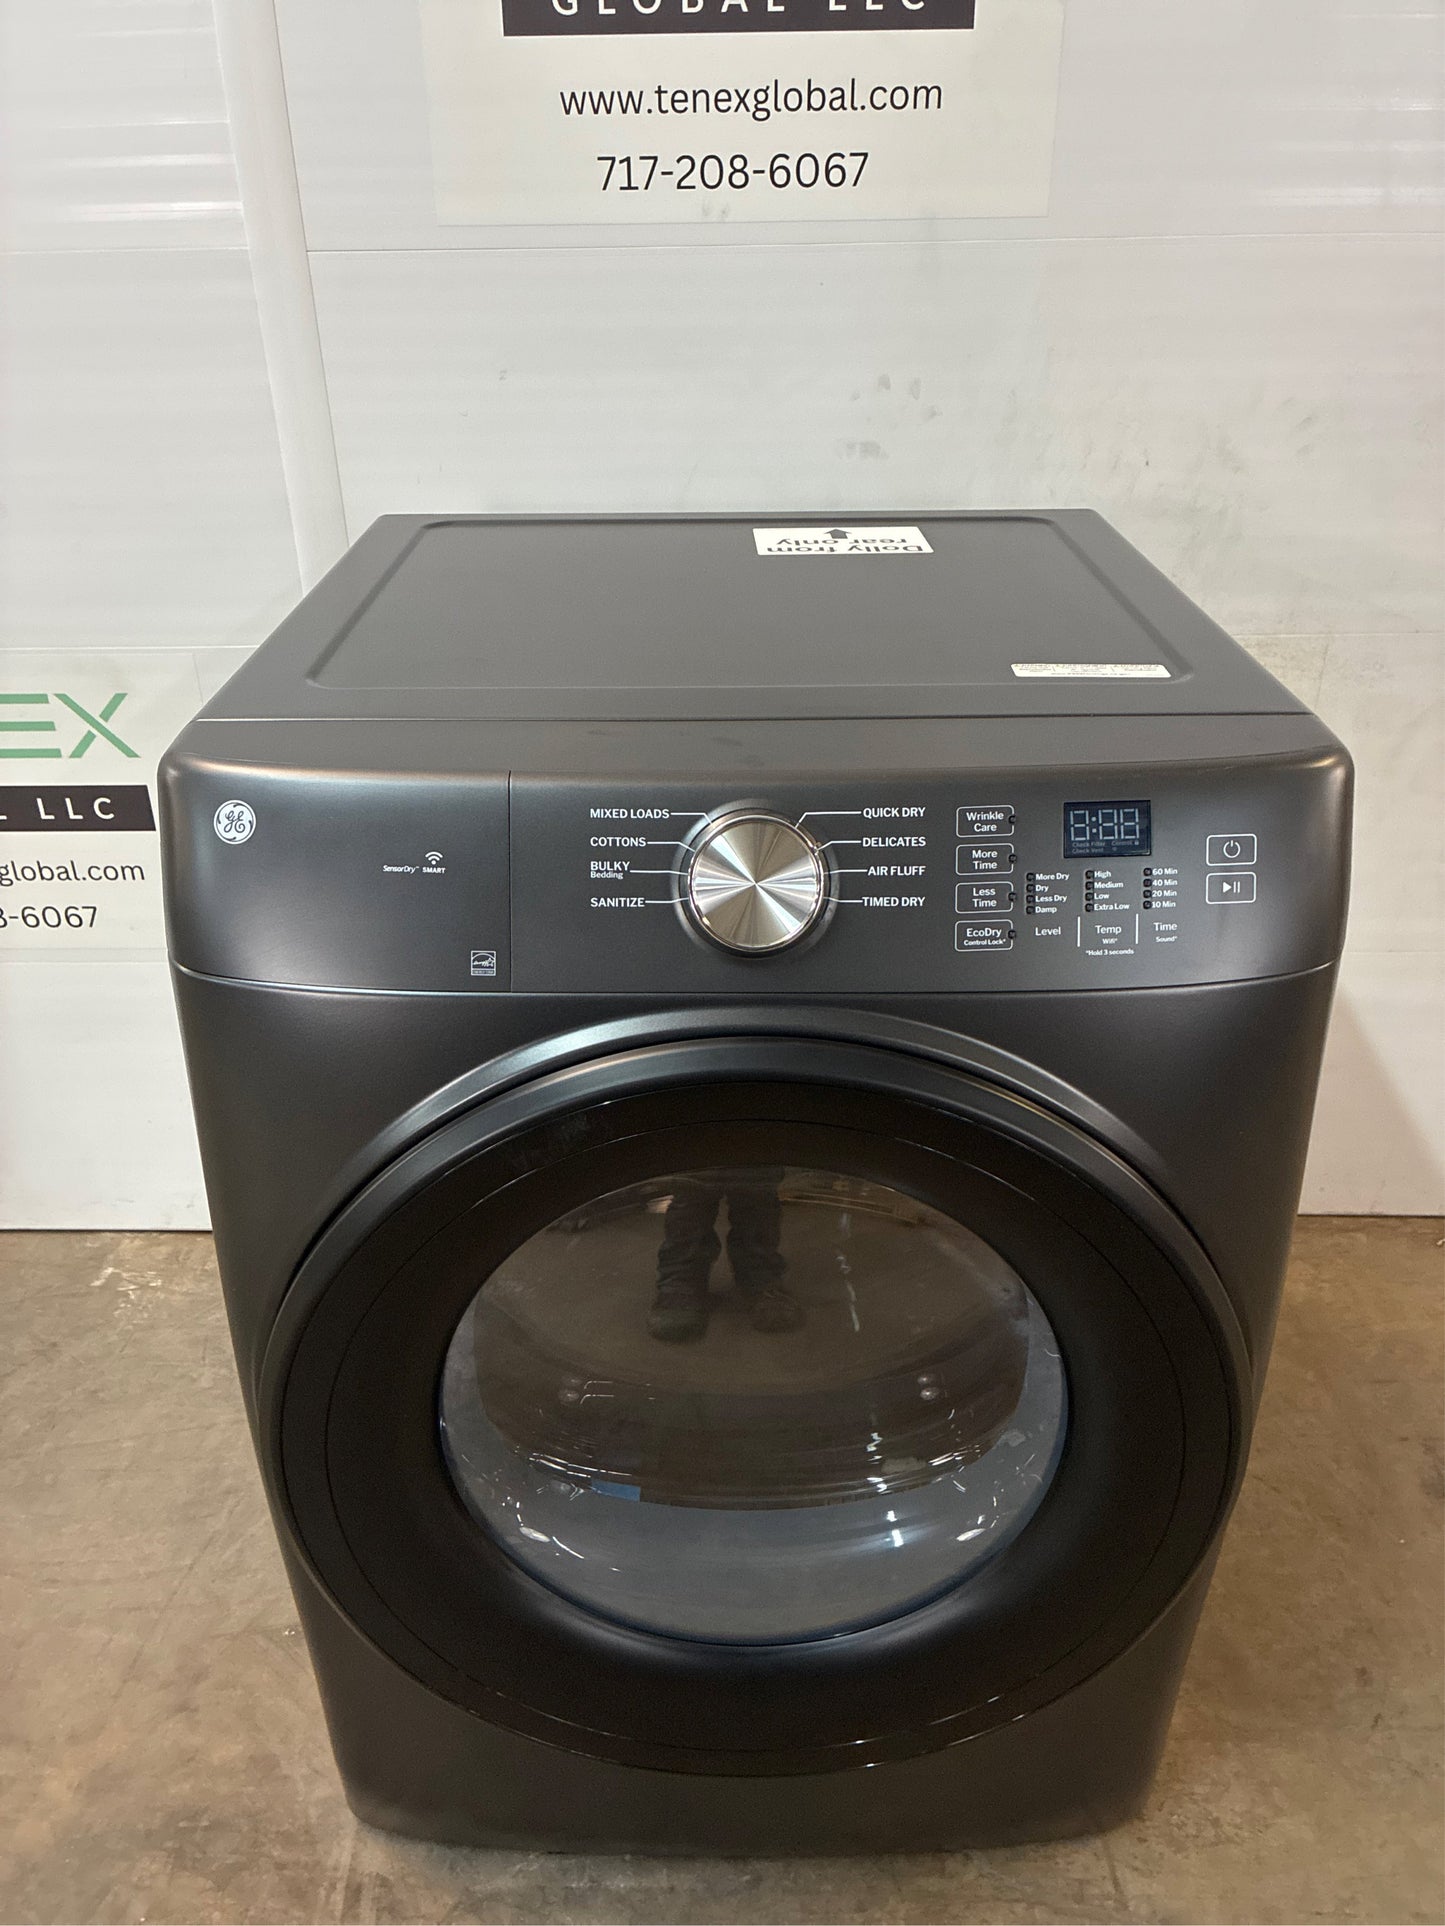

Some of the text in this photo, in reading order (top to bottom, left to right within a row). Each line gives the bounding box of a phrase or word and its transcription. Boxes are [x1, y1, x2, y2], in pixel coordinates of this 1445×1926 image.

[560, 79, 943, 121] www.tenexglobal.com
[597, 152, 869, 191] 717-208-6067
[777, 538, 839, 546] only
[848, 545, 924, 553] Dolly
[36, 797, 115, 820] LLC
[863, 807, 926, 819] QUICK DRY
[590, 808, 670, 819] MIXED LOADS
[966, 811, 1004, 821] Wrinkle
[973, 823, 997, 832] Care
[590, 836, 647, 847] COTTONS
[862, 836, 927, 847] DELICATES
[972, 849, 998, 858] More
[590, 861, 630, 871] BULKY
[973, 861, 998, 870] Time
[590, 871, 623, 879] Bedding
[867, 865, 926, 876] AIR FLUFF
[1094, 870, 1111, 879] High
[1152, 867, 1178, 876] 60 Min
[1035, 872, 1070, 881] More Dry
[1094, 881, 1124, 889] Medium
[1152, 878, 1178, 887] 40 Min
[973, 887, 996, 897] Less
[1035, 884, 1049, 893] Dry
[1094, 892, 1109, 900] Low
[1152, 889, 1177, 898] 20 Min
[590, 897, 645, 908] SANITIZE
[862, 896, 926, 907] TIMED DRY
[972, 898, 997, 908] Time
[1035, 894, 1068, 903] Less Dry
[1094, 902, 1130, 911] Extra Low
[1162, 900, 1176, 908] Min
[1035, 906, 1057, 915] Damp
[1035, 926, 1061, 936] Level
[1095, 925, 1122, 935] Temp
[1153, 922, 1178, 931] Time
[966, 928, 1002, 938] EcoDry
